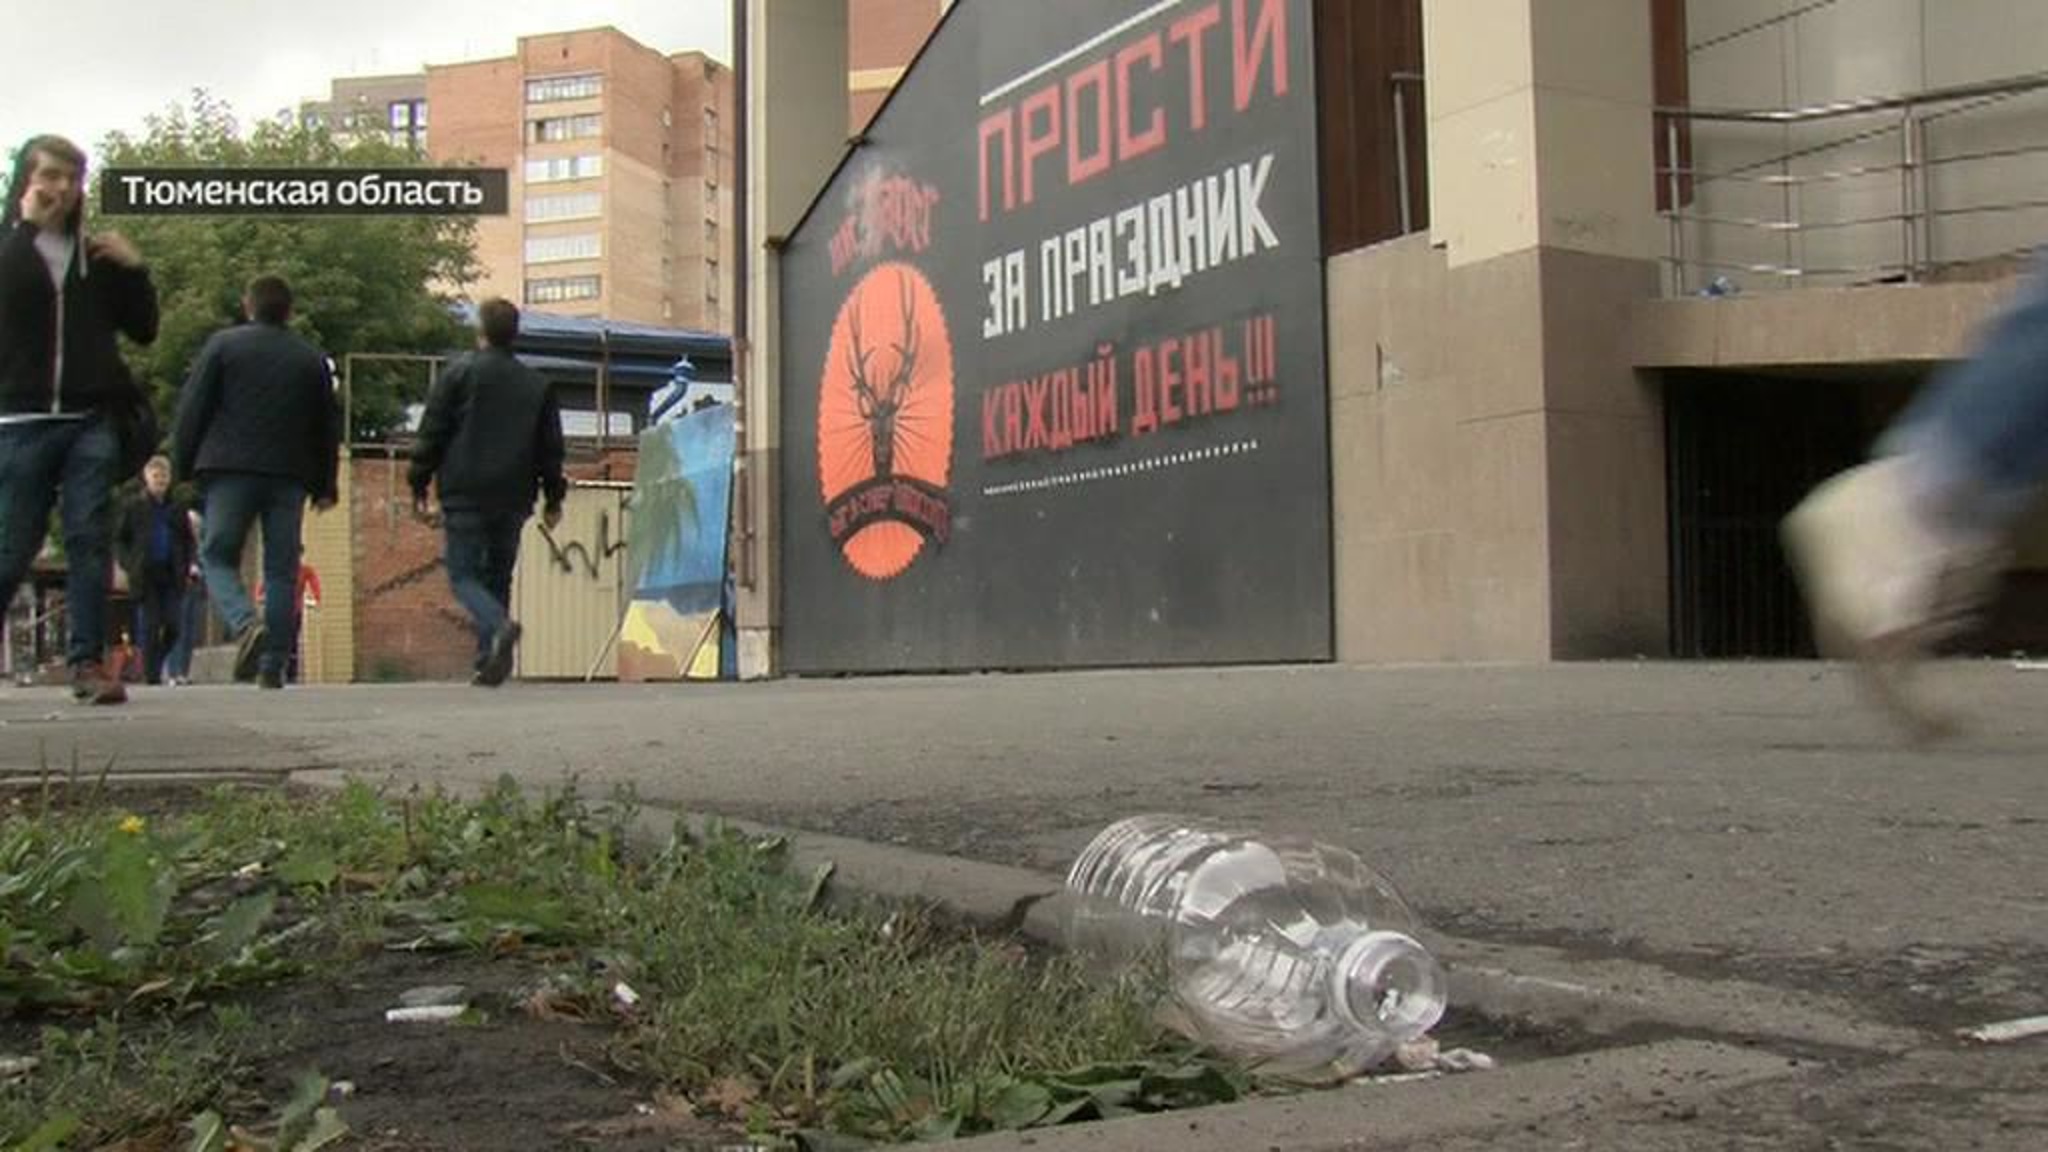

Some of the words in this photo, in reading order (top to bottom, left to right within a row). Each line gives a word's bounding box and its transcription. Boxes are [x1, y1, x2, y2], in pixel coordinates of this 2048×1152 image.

[978, 0, 1288, 222] ПРОСТИ
[983, 249, 1026, 339] ЗА
[1040, 153, 1280, 321] ПРАЗДНИК
[982, 342, 1119, 458] КАЖДЫЙ
